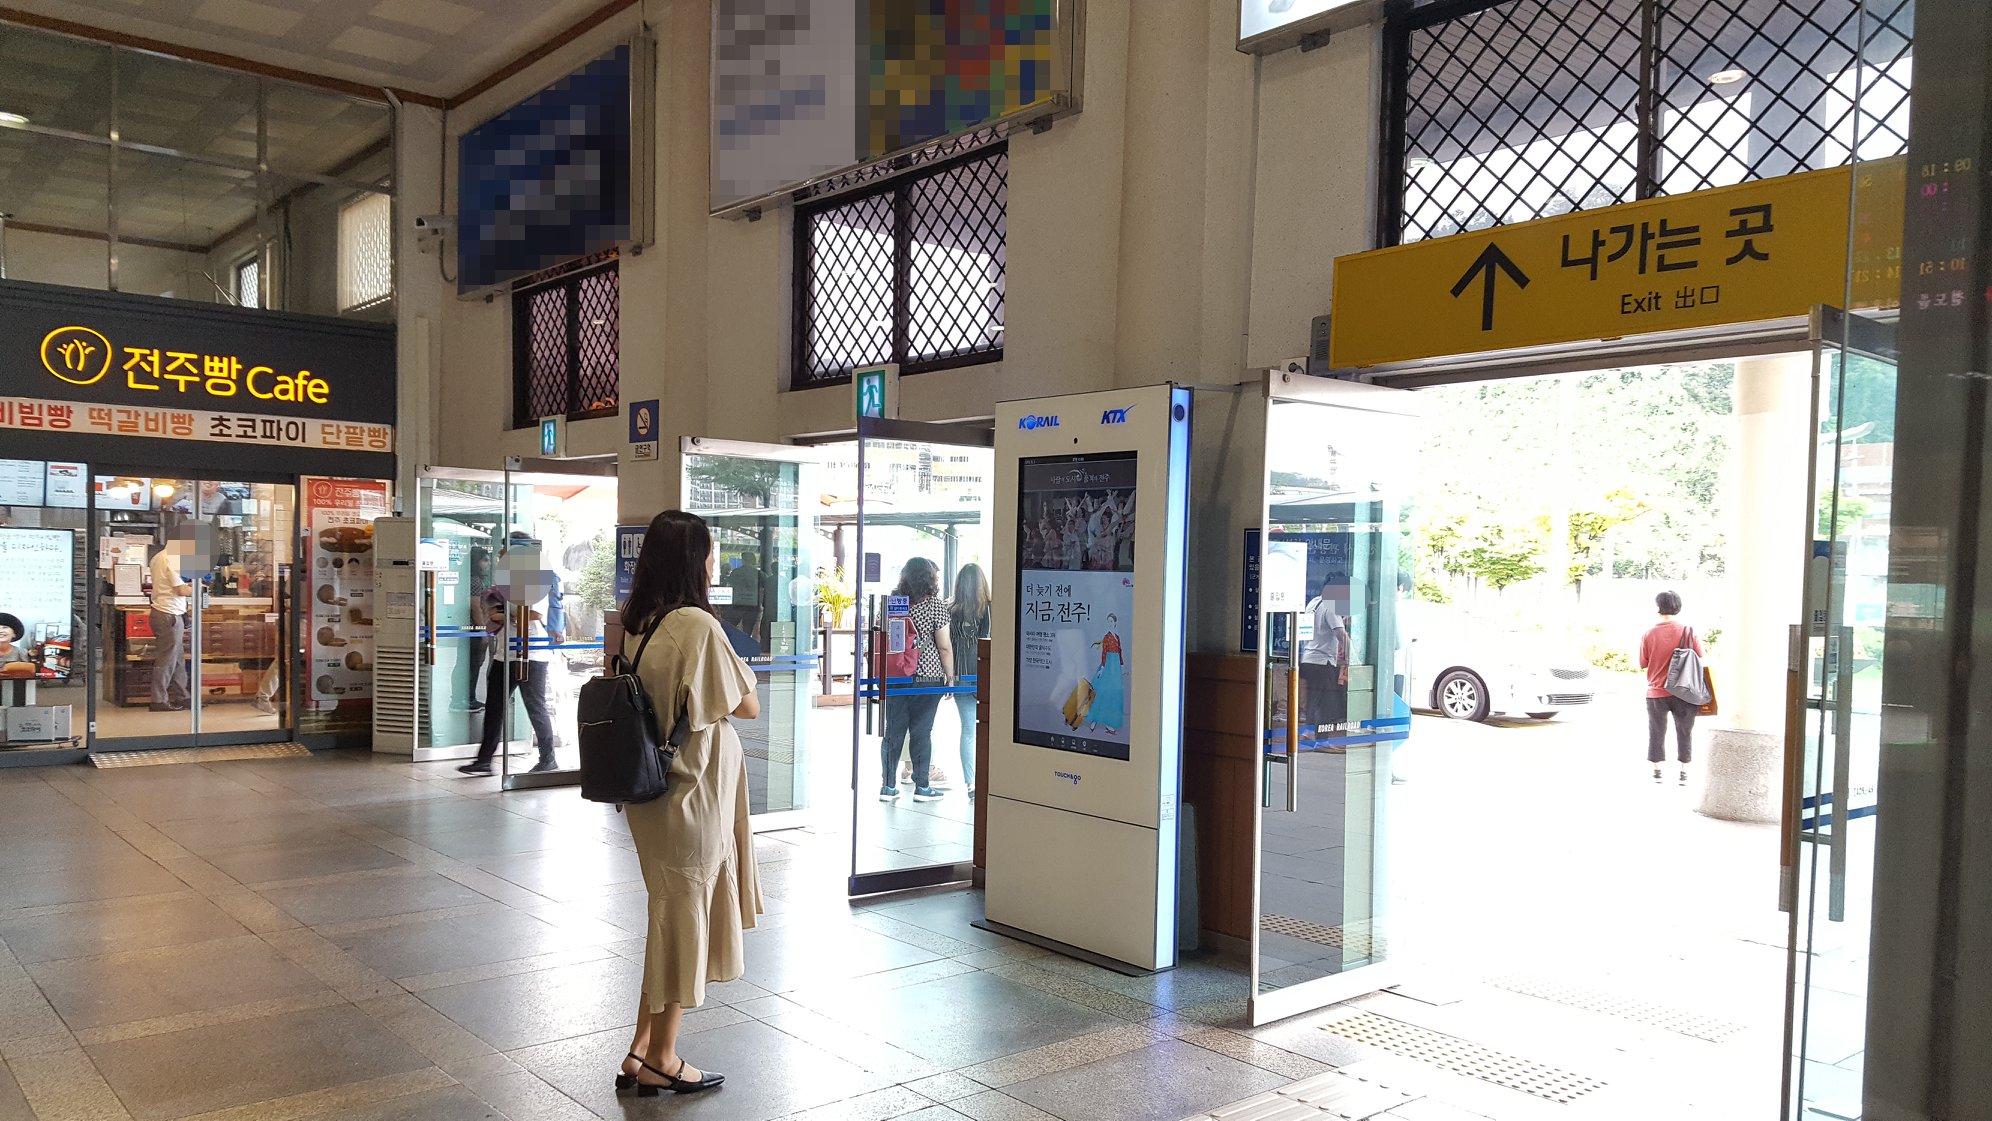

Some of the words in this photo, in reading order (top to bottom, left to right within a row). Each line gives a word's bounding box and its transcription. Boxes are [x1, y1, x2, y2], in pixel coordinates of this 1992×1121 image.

[1561, 218, 1702, 281] 나가는
[1725, 203, 1775, 266] 곳
[1620, 291, 1662, 315] Exit
[1675, 285, 1721, 310] 出口
[122, 346, 243, 397] 전주빵
[246, 366, 330, 404] Cafe
[1019, 414, 1060, 430] KORAIL
[1101, 405, 1132, 424] KTX
[88, 407, 195, 436] 떡갈비빵
[209, 415, 306, 443] 초코파이
[320, 423, 389, 450] 단팥빵
[1026, 583, 1034, 596] 더
[1036, 583, 1052, 597] 늦기
[1055, 584, 1072, 598] 전에
[1026, 600, 1055, 622] 지금,
[1057, 601, 1090, 624] 전주!
[1317, 723, 1335, 733] KOREA
